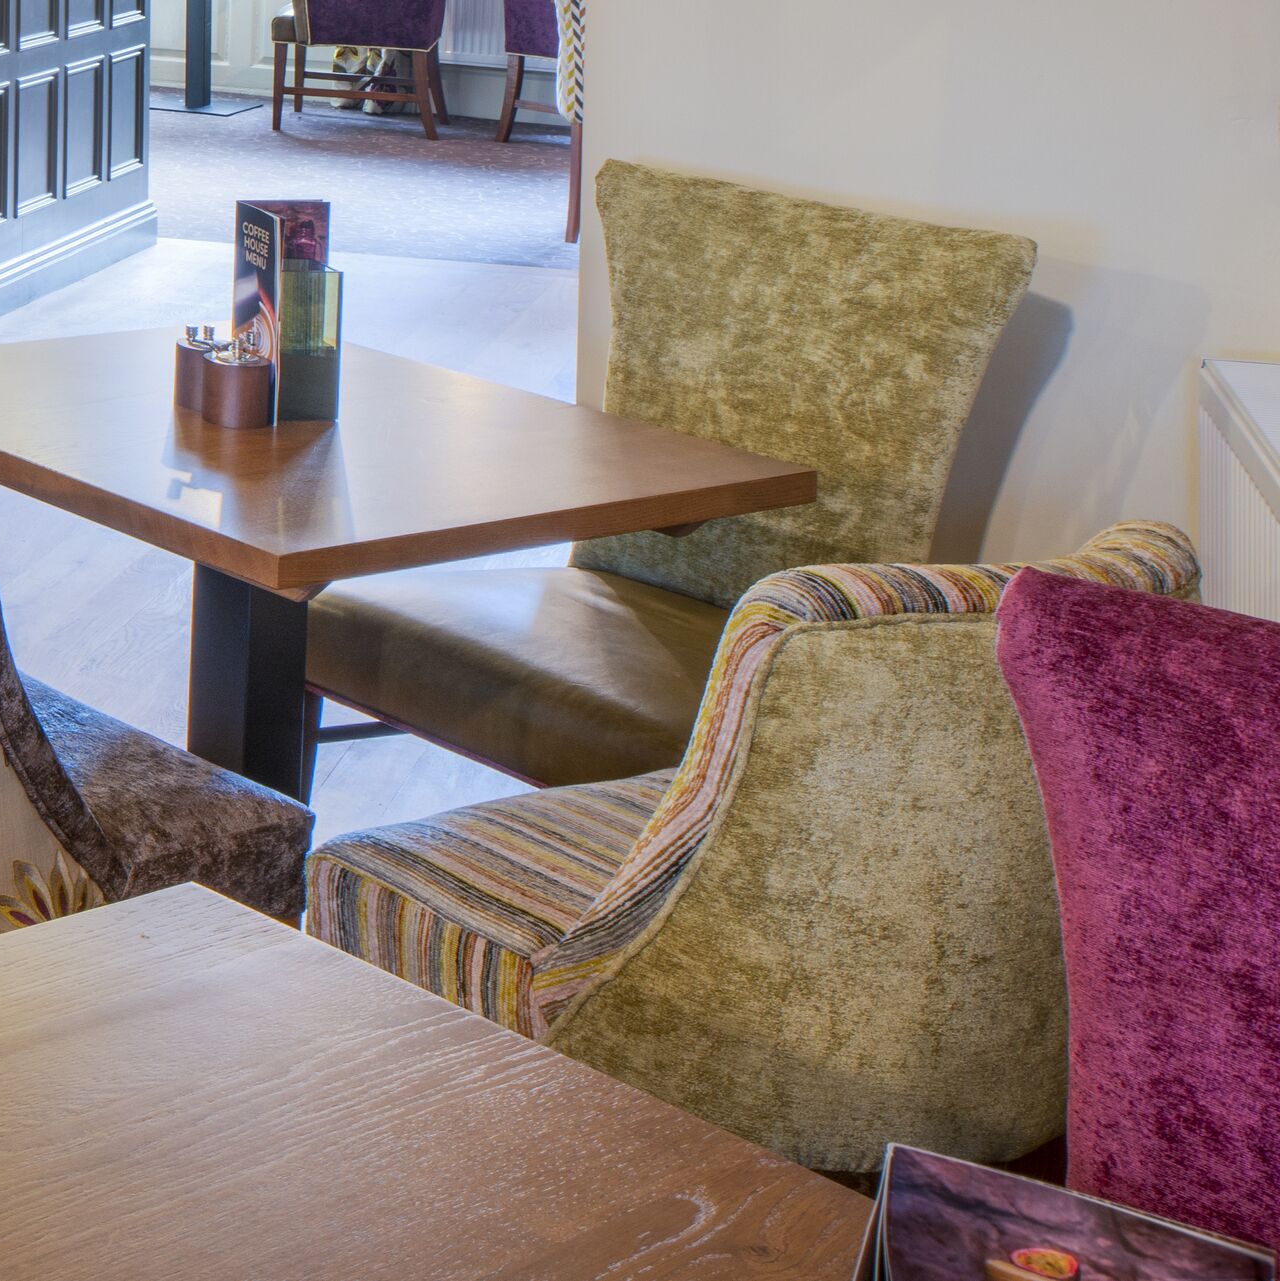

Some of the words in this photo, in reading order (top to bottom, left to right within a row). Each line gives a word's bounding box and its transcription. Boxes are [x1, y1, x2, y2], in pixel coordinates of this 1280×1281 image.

[242, 221, 270, 245] COFFEE
[243, 235, 268, 258] HOUSE
[245, 250, 267, 271] MENU
